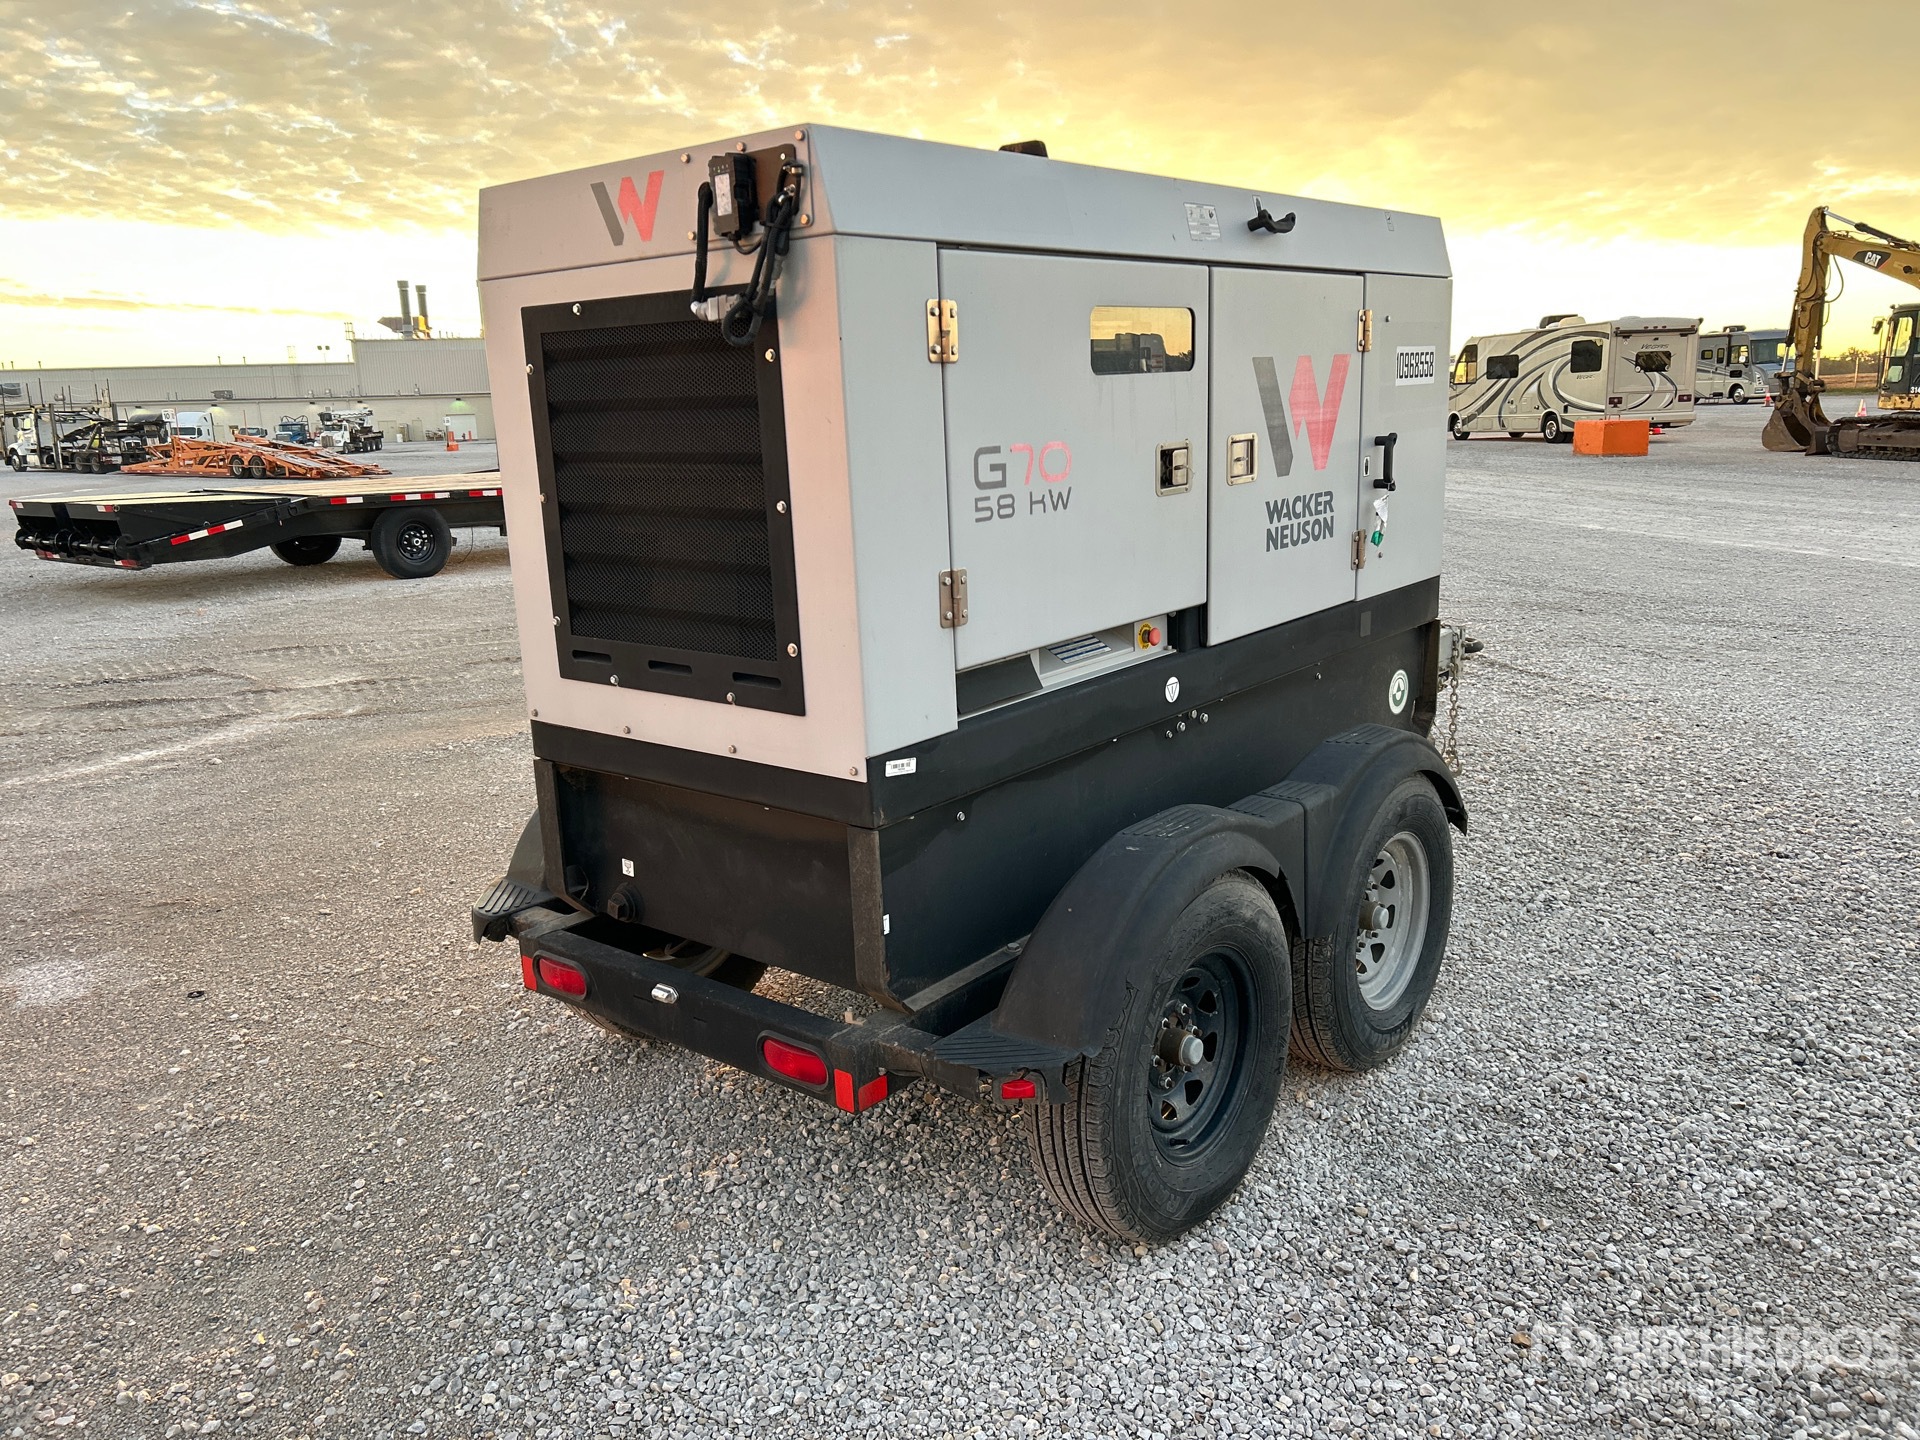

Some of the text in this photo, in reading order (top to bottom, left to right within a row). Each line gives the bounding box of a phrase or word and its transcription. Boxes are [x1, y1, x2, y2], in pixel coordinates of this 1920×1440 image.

[1864, 251, 1882, 267] CAT
[1396, 352, 1435, 379] 10968558
[973, 440, 1073, 490] G70
[974, 493, 1016, 523] 58
[1265, 490, 1335, 525] WACKER
[1266, 515, 1335, 552] NEUSON
